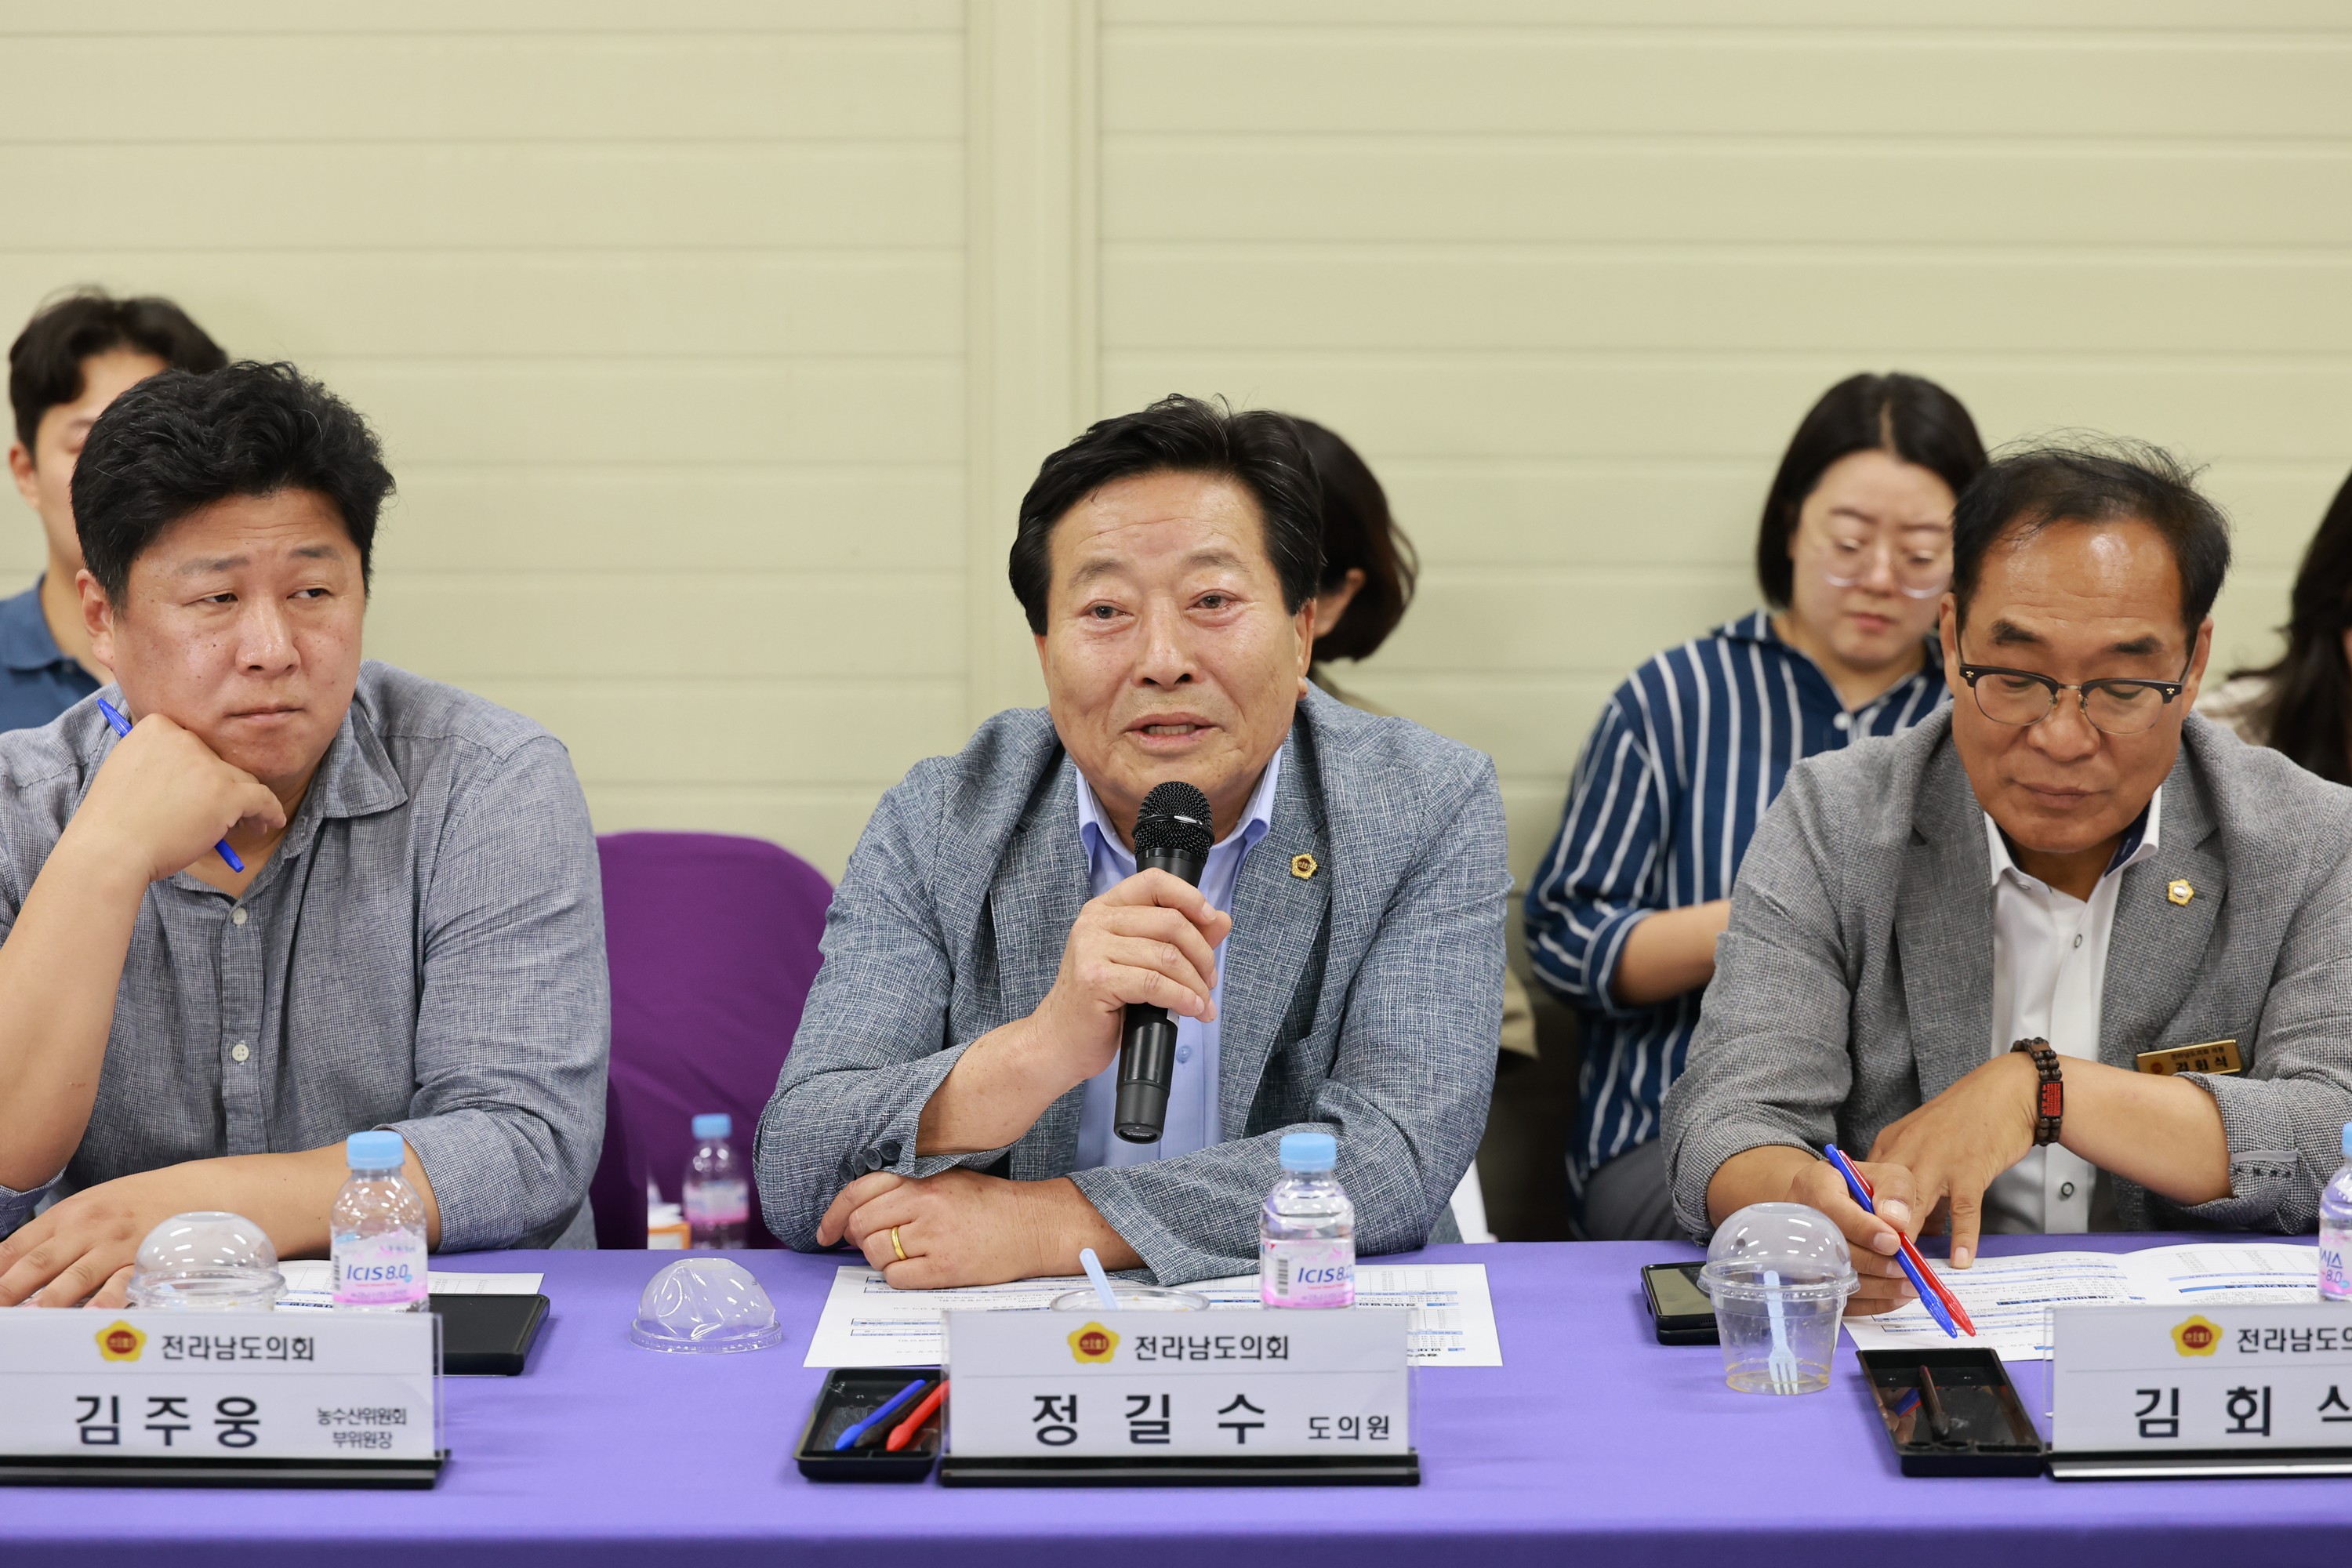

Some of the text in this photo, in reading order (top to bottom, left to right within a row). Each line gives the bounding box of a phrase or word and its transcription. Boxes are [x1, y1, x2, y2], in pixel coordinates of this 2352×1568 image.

[2325, 1269, 2343, 1283] 8.0
[161, 1334, 314, 1361] 전라남도의회
[1134, 1335, 1289, 1361] 전라남도의회
[317, 1407, 407, 1425] 농수산위원회
[1308, 1415, 1390, 1441] 도의원
[332, 1431, 393, 1449] 부위원장
